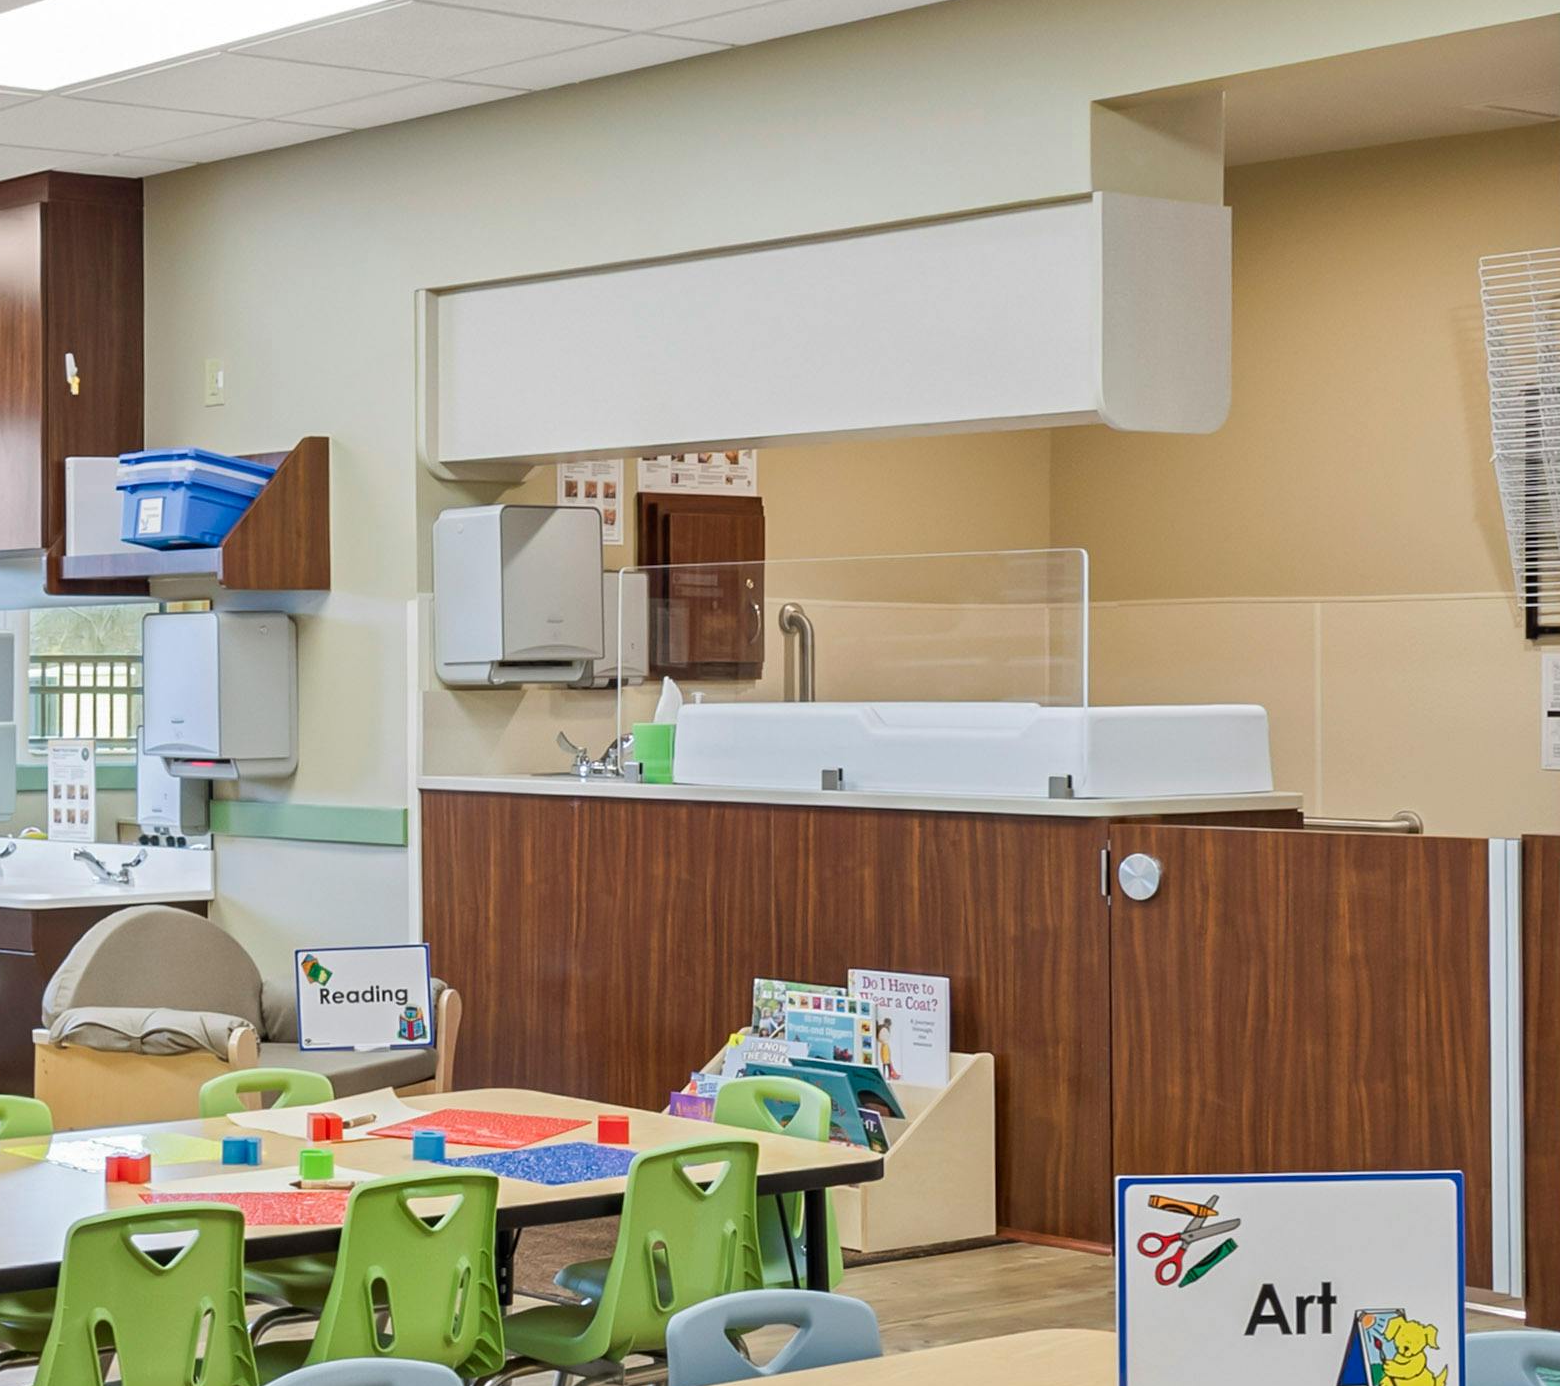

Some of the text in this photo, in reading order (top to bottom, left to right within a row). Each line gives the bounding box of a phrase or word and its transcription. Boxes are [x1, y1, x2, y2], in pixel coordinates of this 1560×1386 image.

[862, 976, 935, 996] Do I Have to
[319, 985, 409, 1006] Reading
[895, 997, 903, 1008] a
[905, 996, 938, 1012] Coat?
[743, 1052, 760, 1061] THE
[758, 1042, 789, 1054] KNOW
[1243, 1281, 1338, 1336] Art
